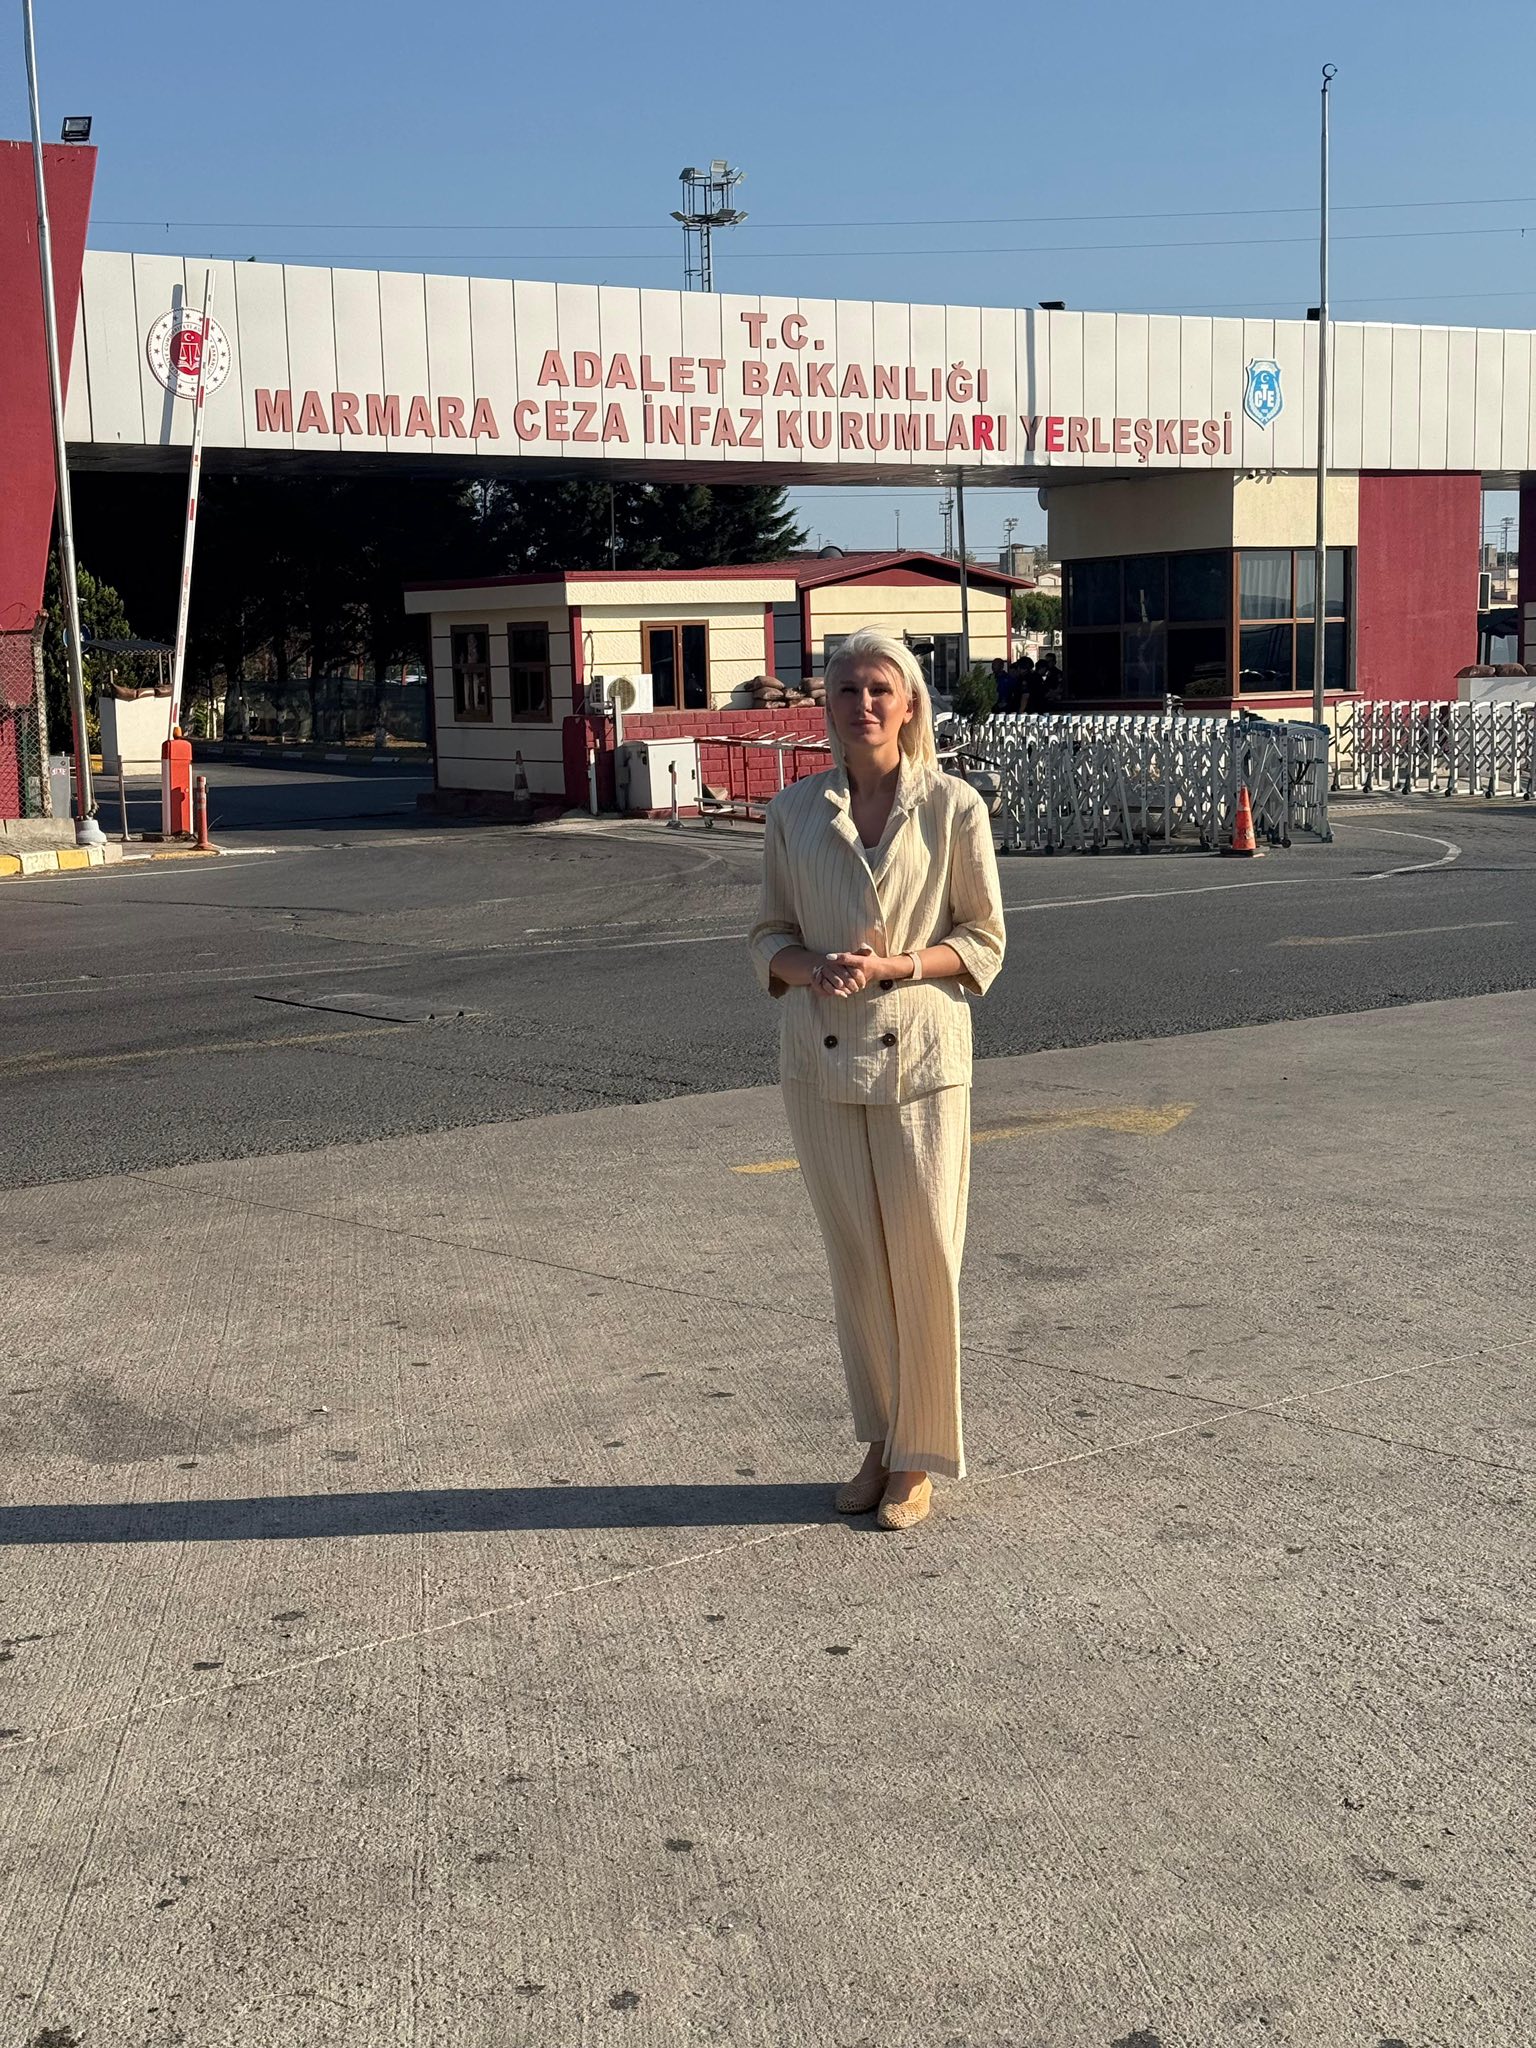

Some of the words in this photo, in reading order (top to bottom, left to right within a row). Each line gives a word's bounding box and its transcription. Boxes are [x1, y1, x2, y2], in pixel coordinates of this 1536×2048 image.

[741, 313, 825, 351] T.C.
[537, 349, 727, 395] ADALET
[743, 360, 989, 404] BAKANLIĞI
[255, 388, 500, 440] MARMARA
[513, 398, 630, 443] CEZA
[644, 395, 765, 449] İNFAZ
[777, 409, 1008, 453] KURUMLARI
[1020, 411, 1233, 463] YERLEŞKESİ
